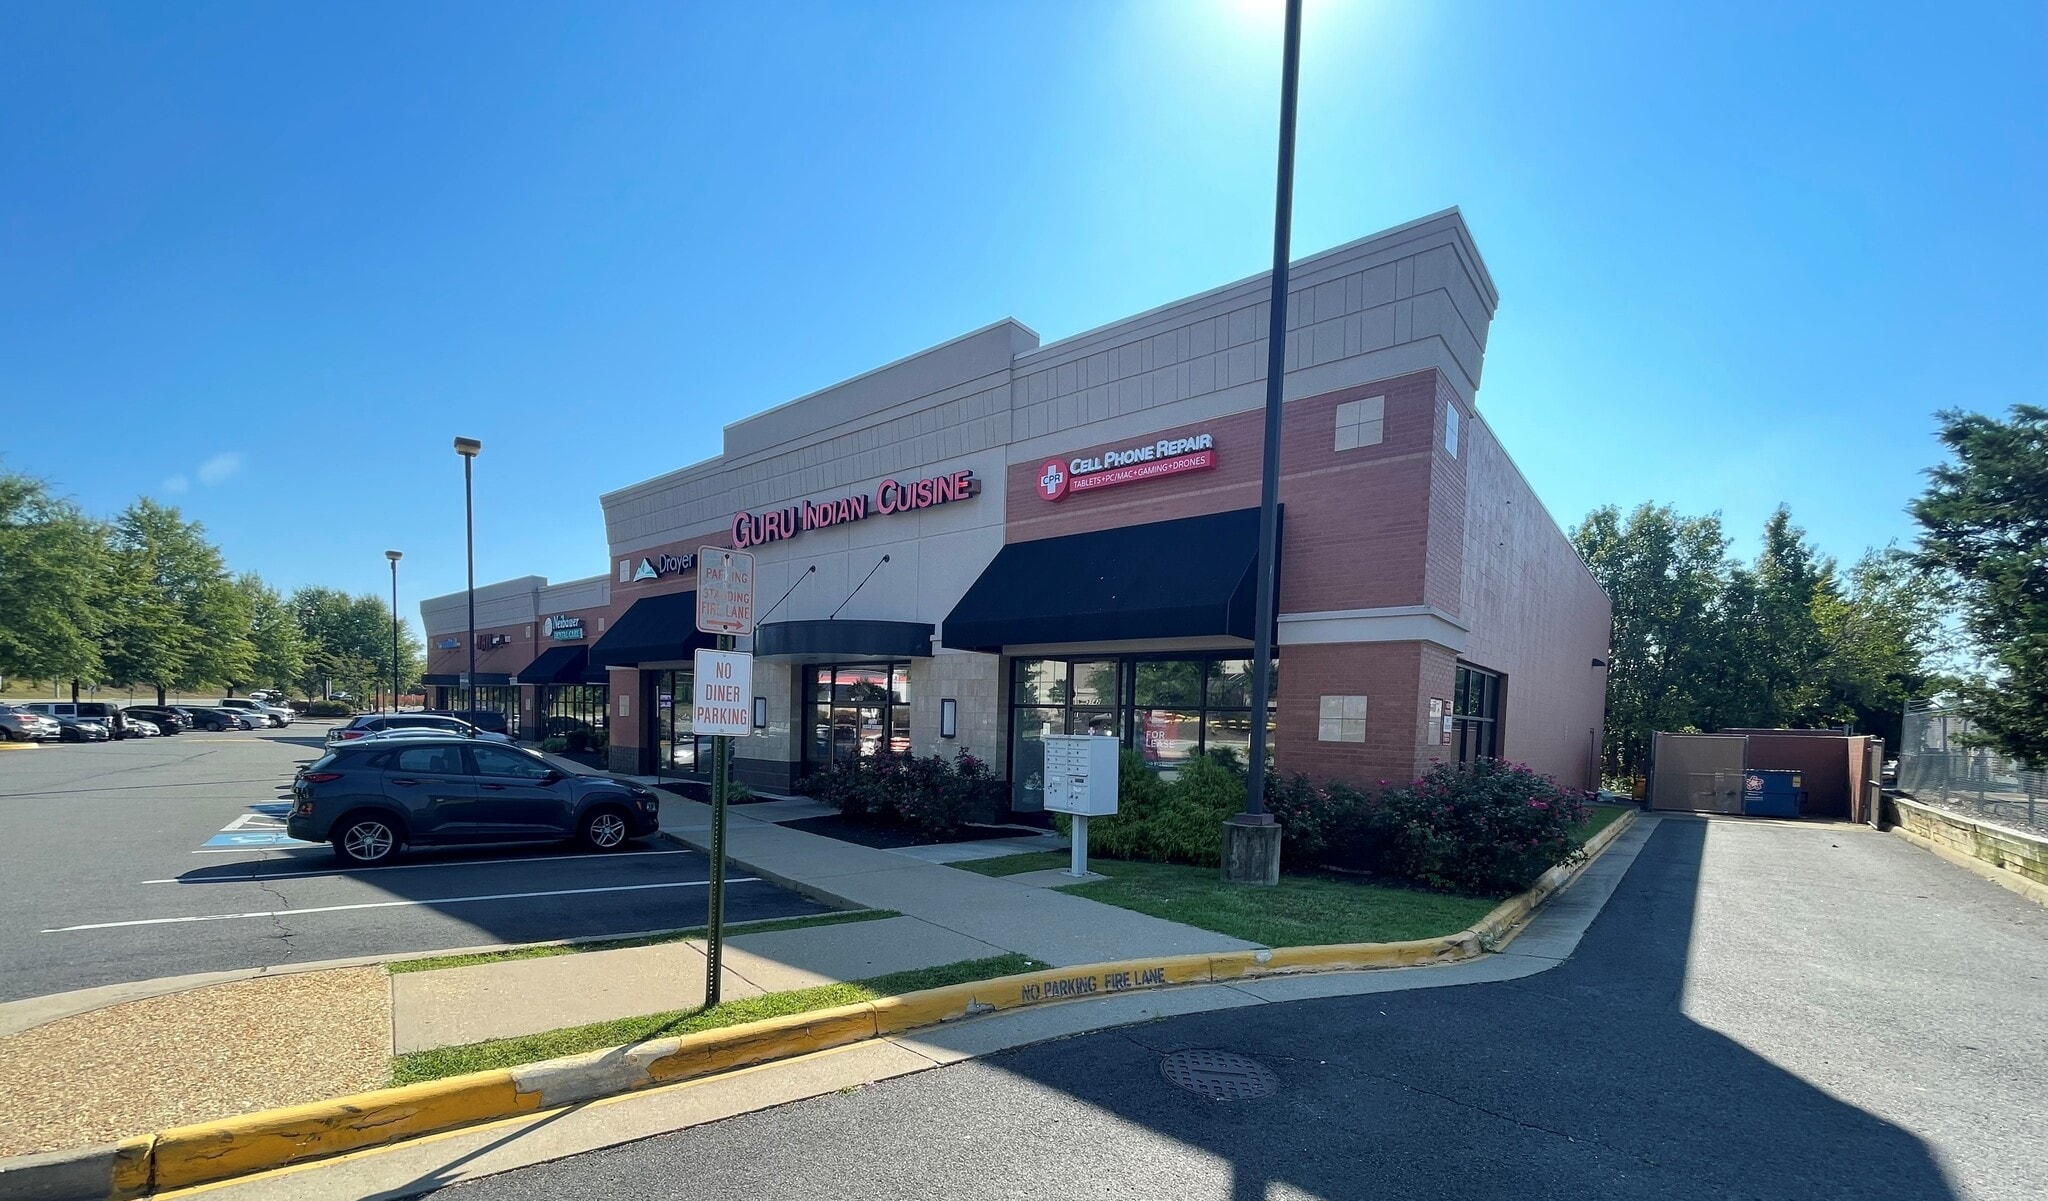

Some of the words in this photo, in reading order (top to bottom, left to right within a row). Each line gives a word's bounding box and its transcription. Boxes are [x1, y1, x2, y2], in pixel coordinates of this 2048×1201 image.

[1069, 457, 1103, 475] CELL
[1103, 446, 1155, 468] PHONE
[1156, 433, 1213, 458] REPAIR
[1042, 474, 1061, 486] CPR
[731, 507, 797, 548] GURU
[802, 495, 867, 530] INDIAN
[876, 470, 972, 515] CUISINE
[659, 553, 694, 574] Drayer
[702, 588, 750, 604] STADING
[726, 604, 750, 620] LANE
[716, 661, 732, 679] NO
[705, 684, 740, 702] DINER
[697, 706, 747, 725] PARKING
[1145, 738, 1175, 749] LEASE
[1146, 730, 1165, 739] FOR
[1021, 983, 1040, 1000] NO
[1044, 976, 1097, 998] PARKING
[1104, 971, 1130, 989] FIRE
[1134, 967, 1165, 985] LANE
